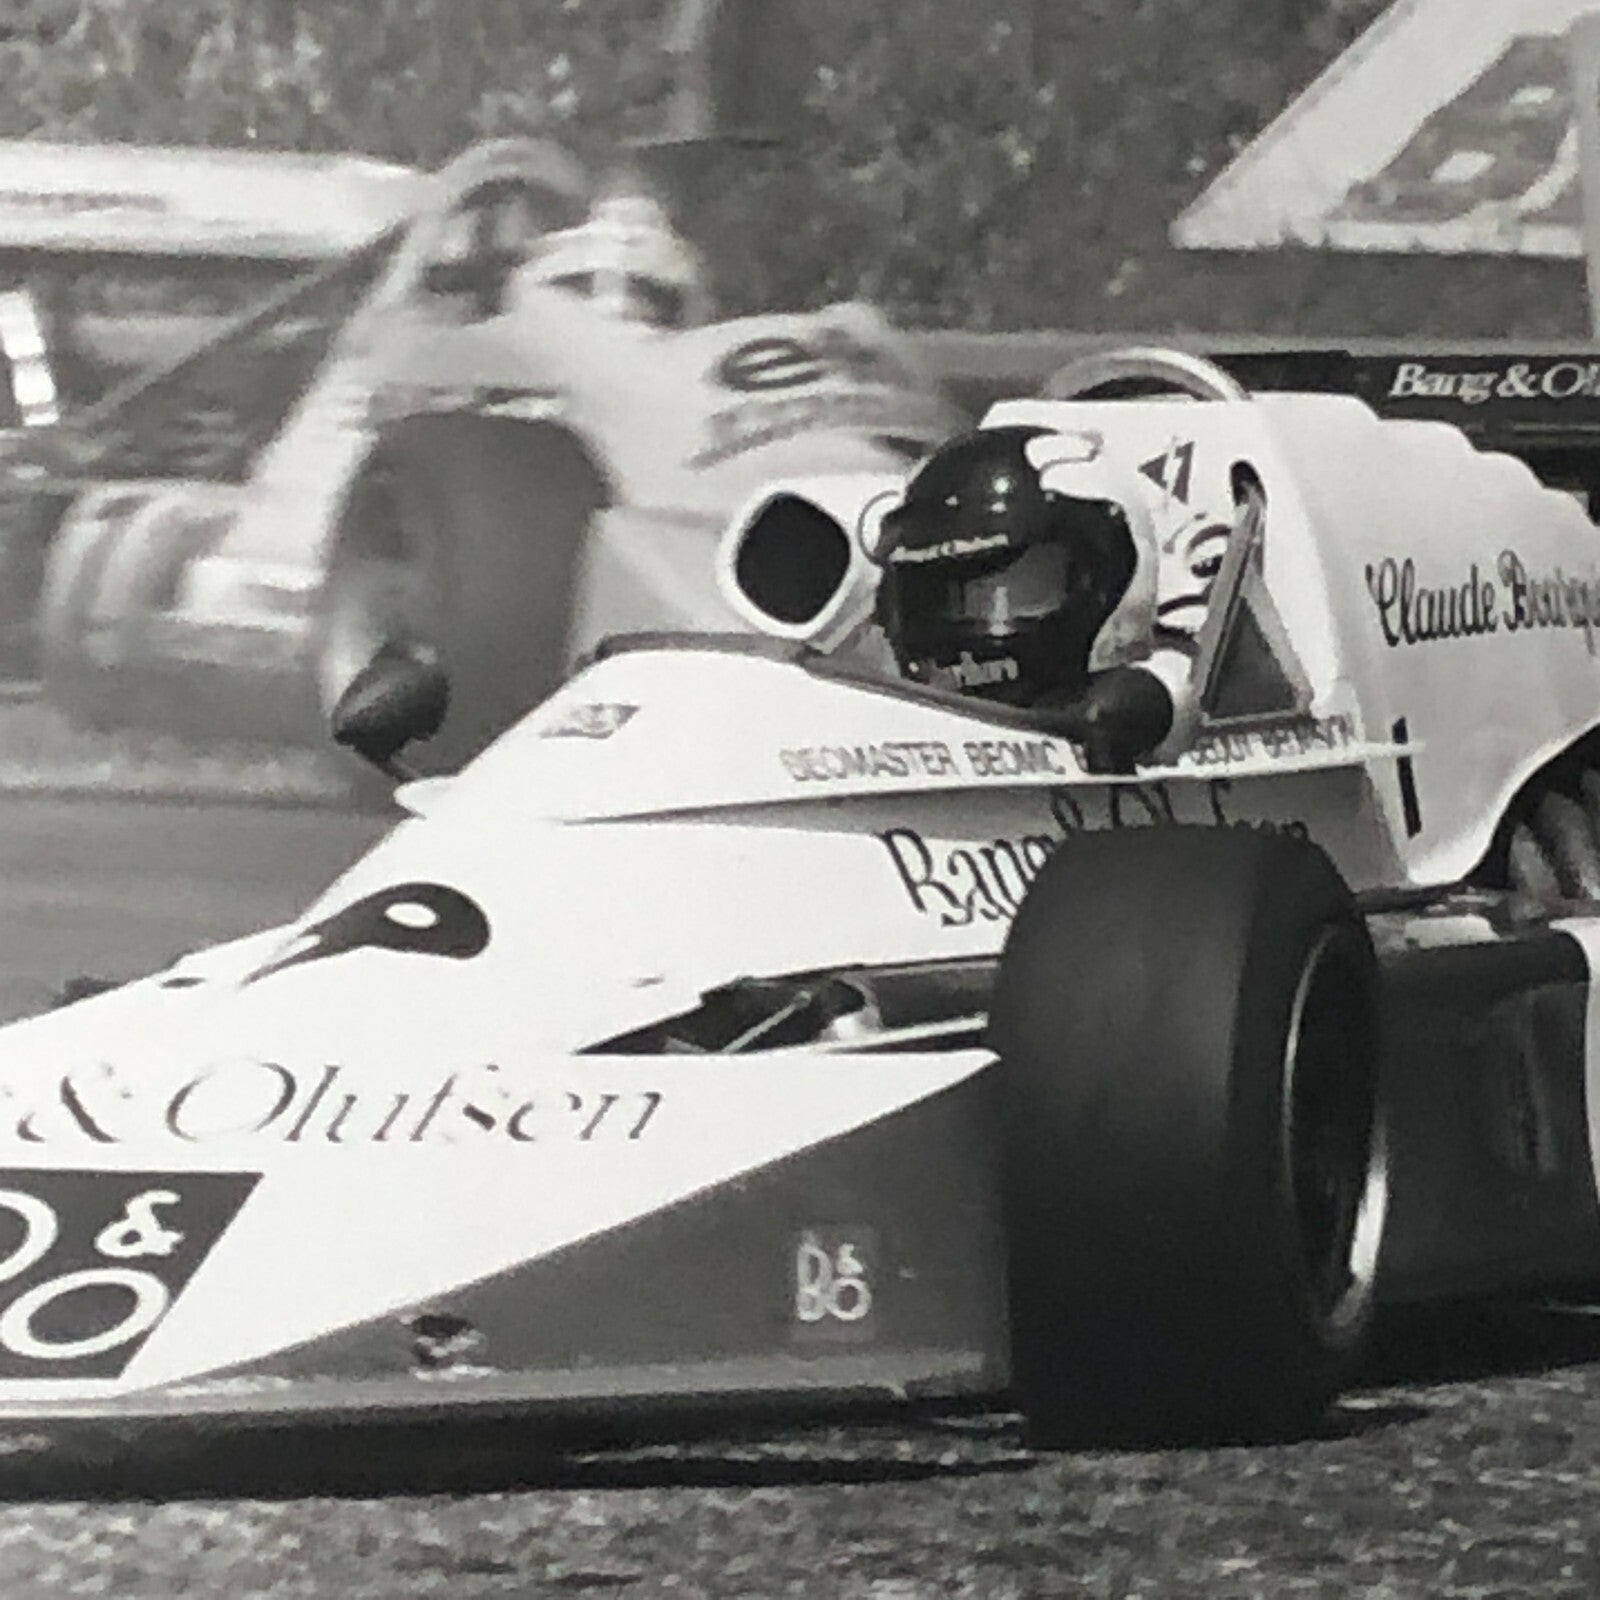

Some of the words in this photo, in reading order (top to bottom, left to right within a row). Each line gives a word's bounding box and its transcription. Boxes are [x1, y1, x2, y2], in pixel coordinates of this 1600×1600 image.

[1387, 362, 1500, 404] Bang
[1364, 556, 1498, 648] Claude
[164, 1056, 663, 1144] Olufsen
